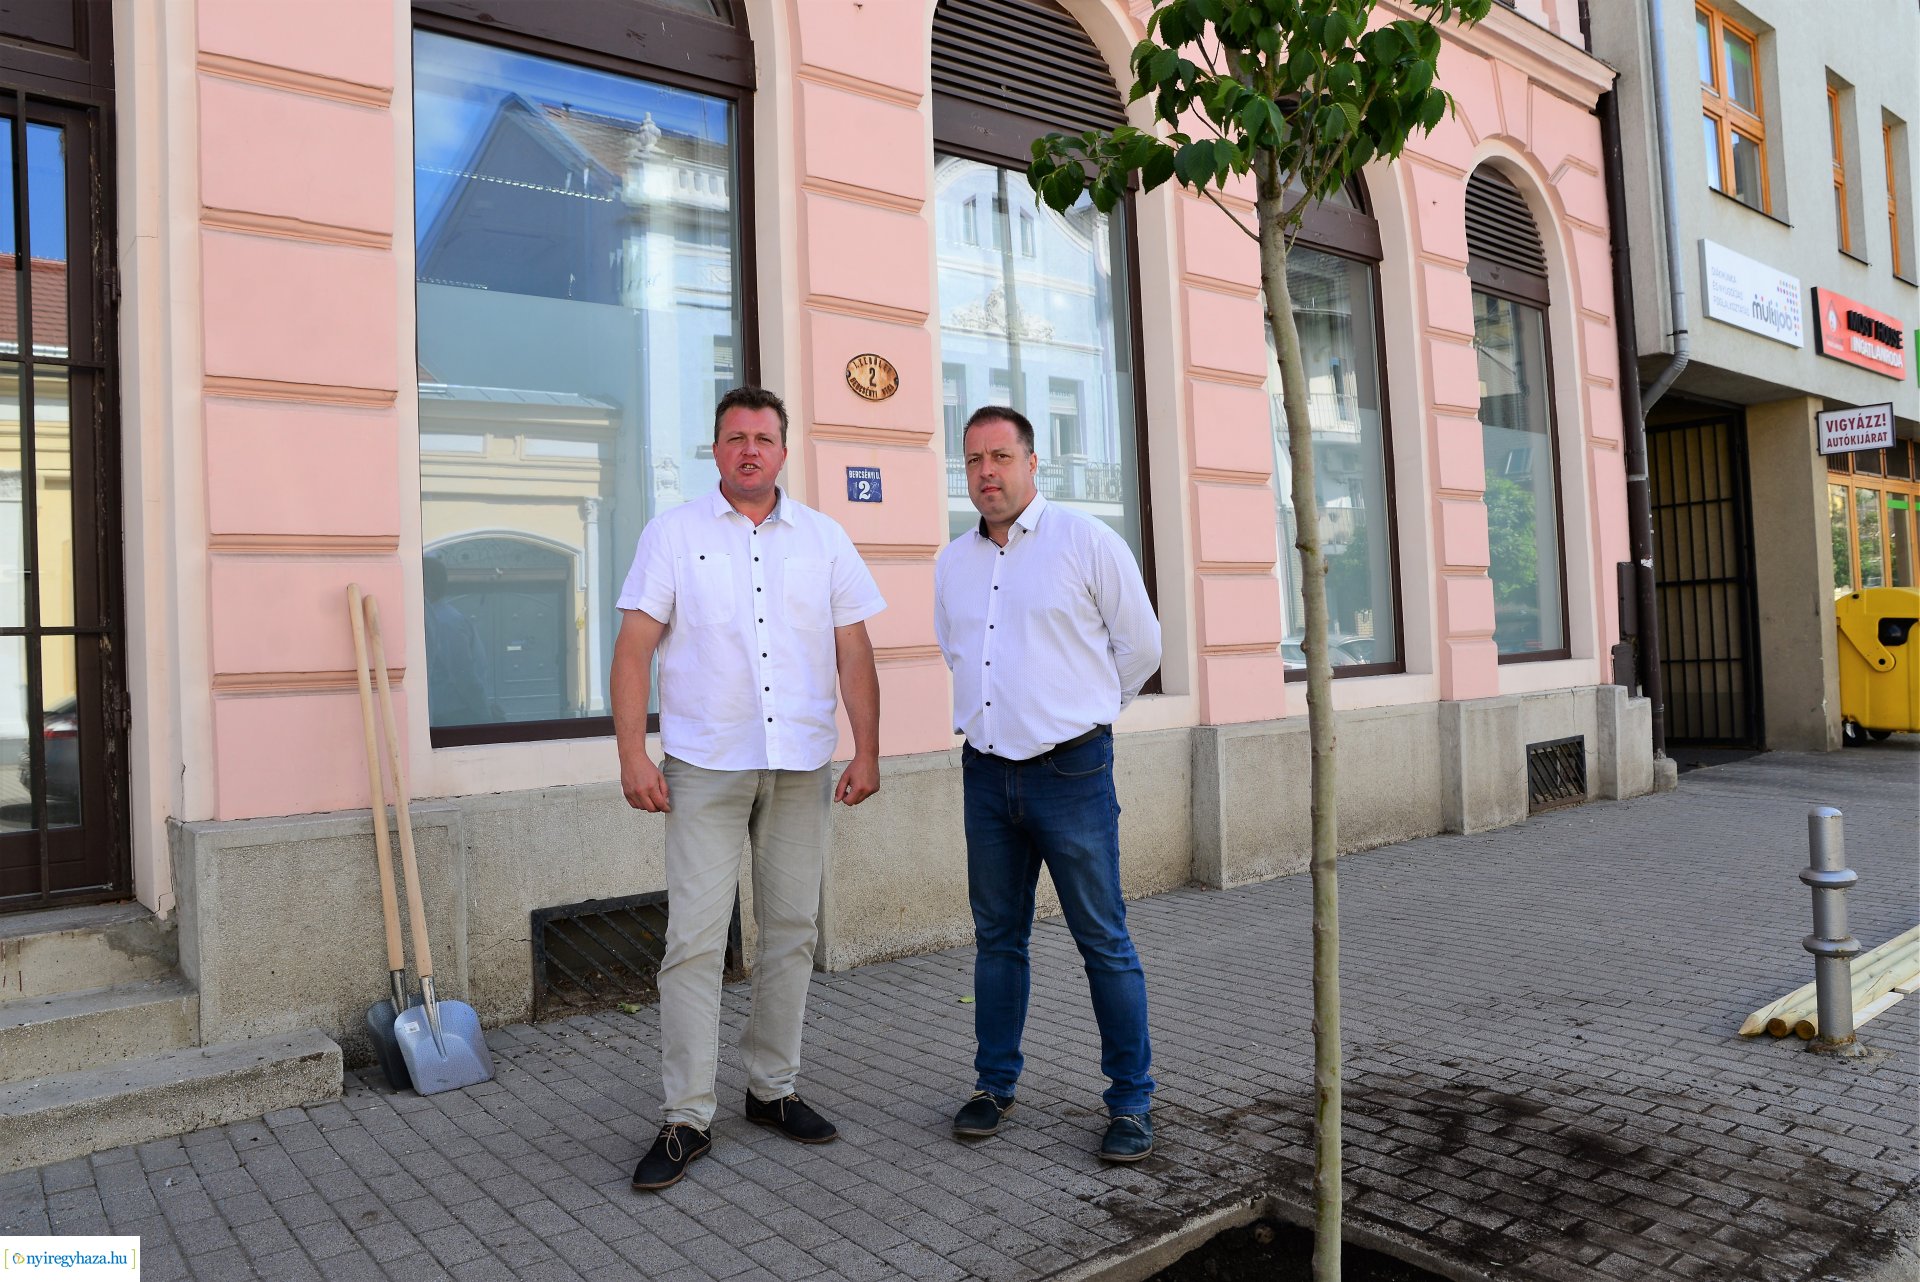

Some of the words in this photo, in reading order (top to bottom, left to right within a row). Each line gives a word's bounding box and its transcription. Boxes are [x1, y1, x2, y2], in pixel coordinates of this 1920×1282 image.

[1752, 297, 1793, 332] multijob
[1847, 310, 1875, 337] MOST
[1874, 320, 1903, 350] HOUSE
[869, 367, 877, 387] 2
[1826, 412, 1886, 433] VIGYÁZZ!
[1827, 431, 1887, 448] AUTÓKIJÁRAT
[858, 480, 871, 500] 2
